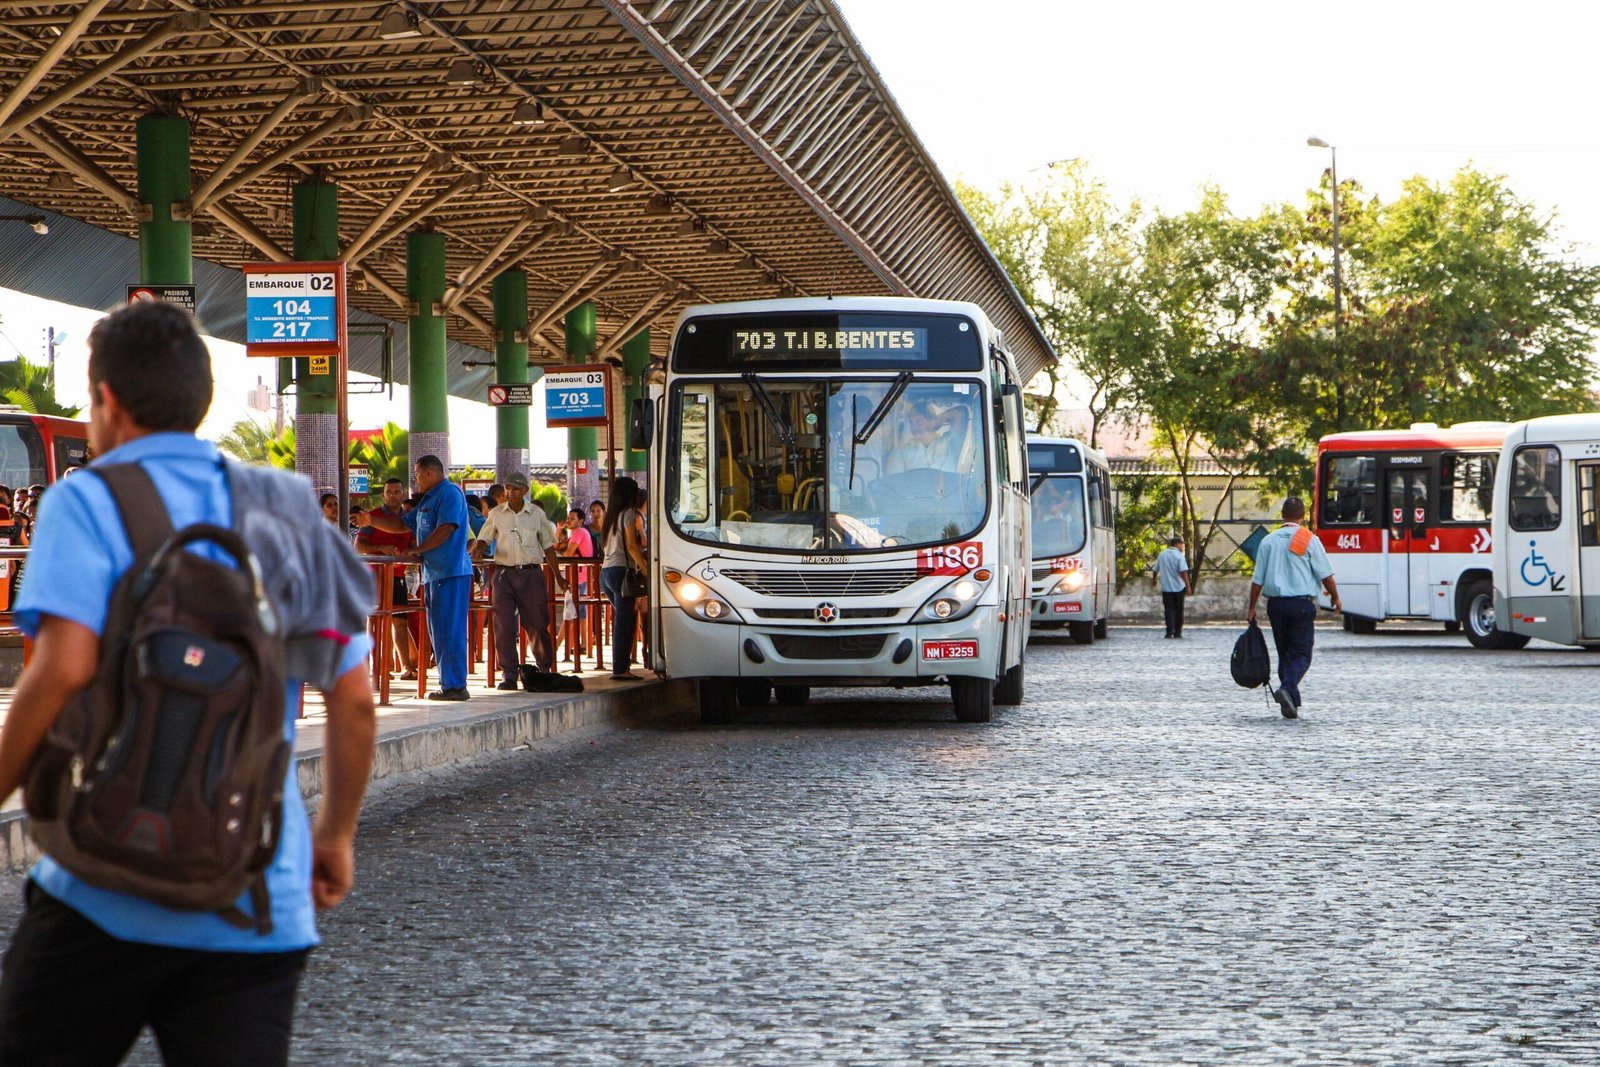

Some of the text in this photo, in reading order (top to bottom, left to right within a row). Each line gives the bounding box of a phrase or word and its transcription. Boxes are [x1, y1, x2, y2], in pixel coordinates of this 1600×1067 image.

[310, 277, 333, 290] 02
[273, 300, 311, 315] 104
[273, 322, 311, 337] 217
[736, 331, 776, 349] 703
[587, 373, 603, 384] 03
[559, 392, 589, 405] 703
[1337, 534, 1361, 549] 4641
[921, 546, 979, 569] 1186
